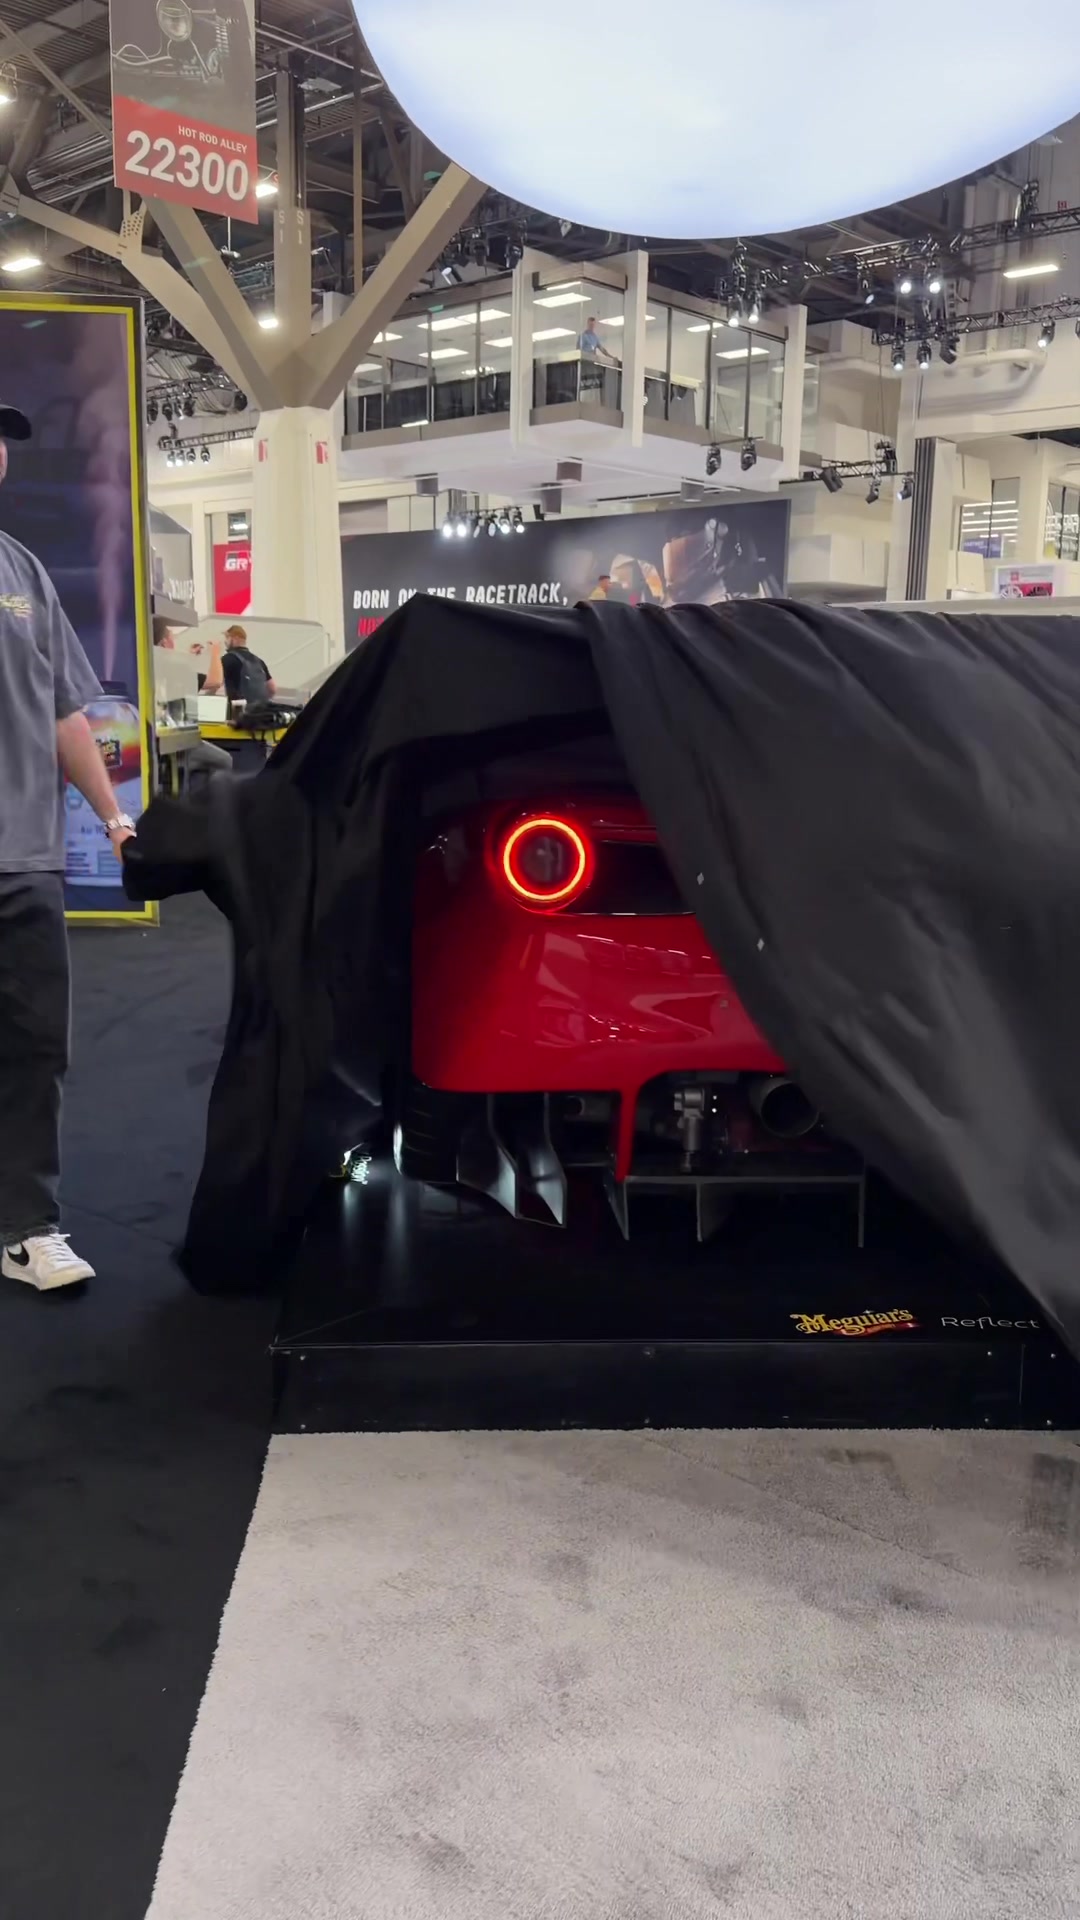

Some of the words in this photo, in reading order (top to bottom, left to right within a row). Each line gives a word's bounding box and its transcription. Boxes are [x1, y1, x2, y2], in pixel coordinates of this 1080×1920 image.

[178, 125, 197, 139] HOT
[199, 131, 218, 145] ROD
[220, 138, 248, 154] ALLEY
[125, 130, 249, 201] 22300
[353, 589, 390, 609] BORN
[466, 582, 568, 606] RACETRACK,
[790, 1309, 913, 1336] Meguiar's
[941, 1316, 1040, 1329] Reflect
